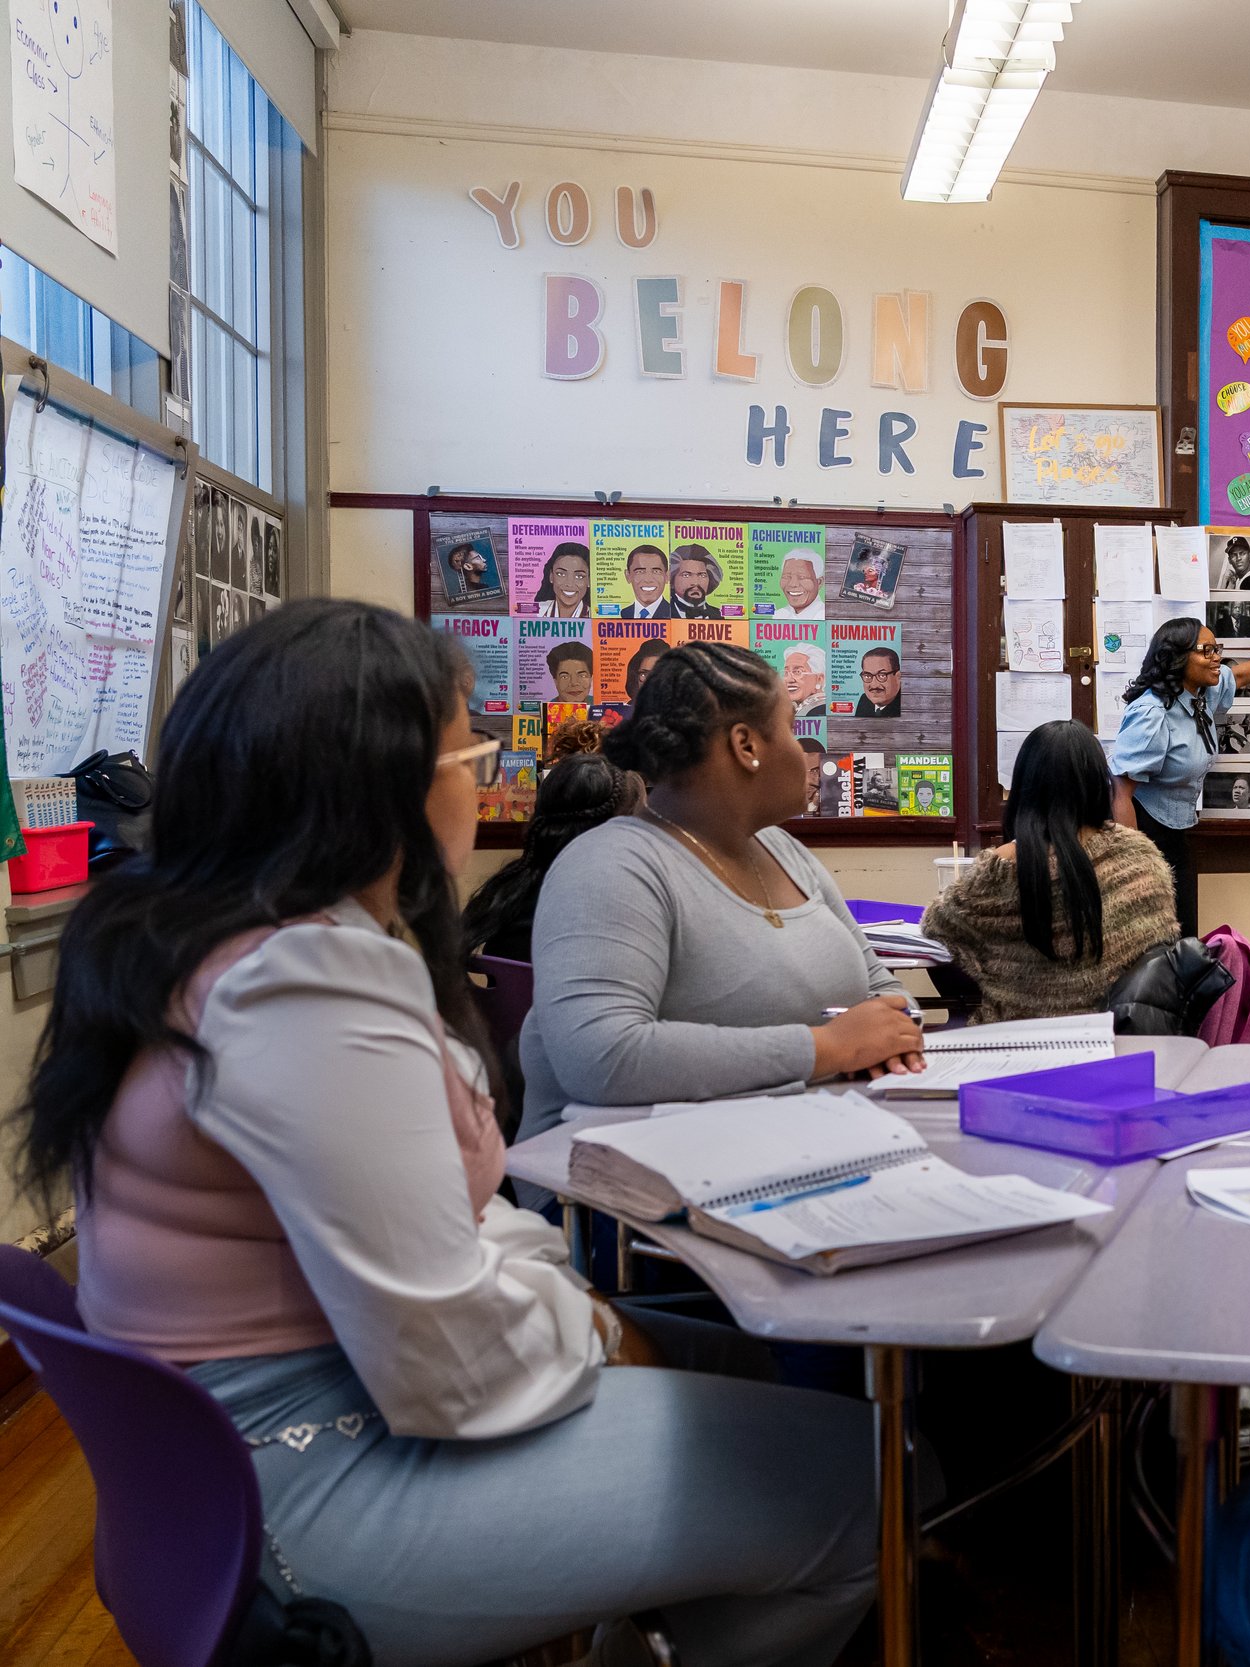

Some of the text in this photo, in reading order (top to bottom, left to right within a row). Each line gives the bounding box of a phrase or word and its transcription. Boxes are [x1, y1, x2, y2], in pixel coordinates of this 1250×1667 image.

[15, 18, 51, 68] Economic
[26, 59, 46, 90] Class
[470, 182, 658, 249] YOU
[544, 274, 1011, 400] BELONG
[1221, 382, 1247, 400] CHOOSE
[747, 404, 990, 479] HERE
[1229, 483, 1245, 499] YOU
[512, 524, 585, 537] DETERMINATION
[593, 523, 665, 538] PERSISTENCE
[674, 525, 743, 541] FOUNDATION
[752, 529, 822, 544] ACHIEVEMENT
[444, 618, 500, 637] LEGACY
[519, 620, 586, 638] EMPATHY
[597, 621, 667, 639] GRATITUDE
[687, 623, 733, 641] BRAVE
[755, 623, 819, 641] EQUALITY
[831, 624, 897, 642] HUMANITY
[505, 759, 534, 768] AMERICA
[900, 756, 950, 766] MANDELA
[838, 770, 851, 817] Black
